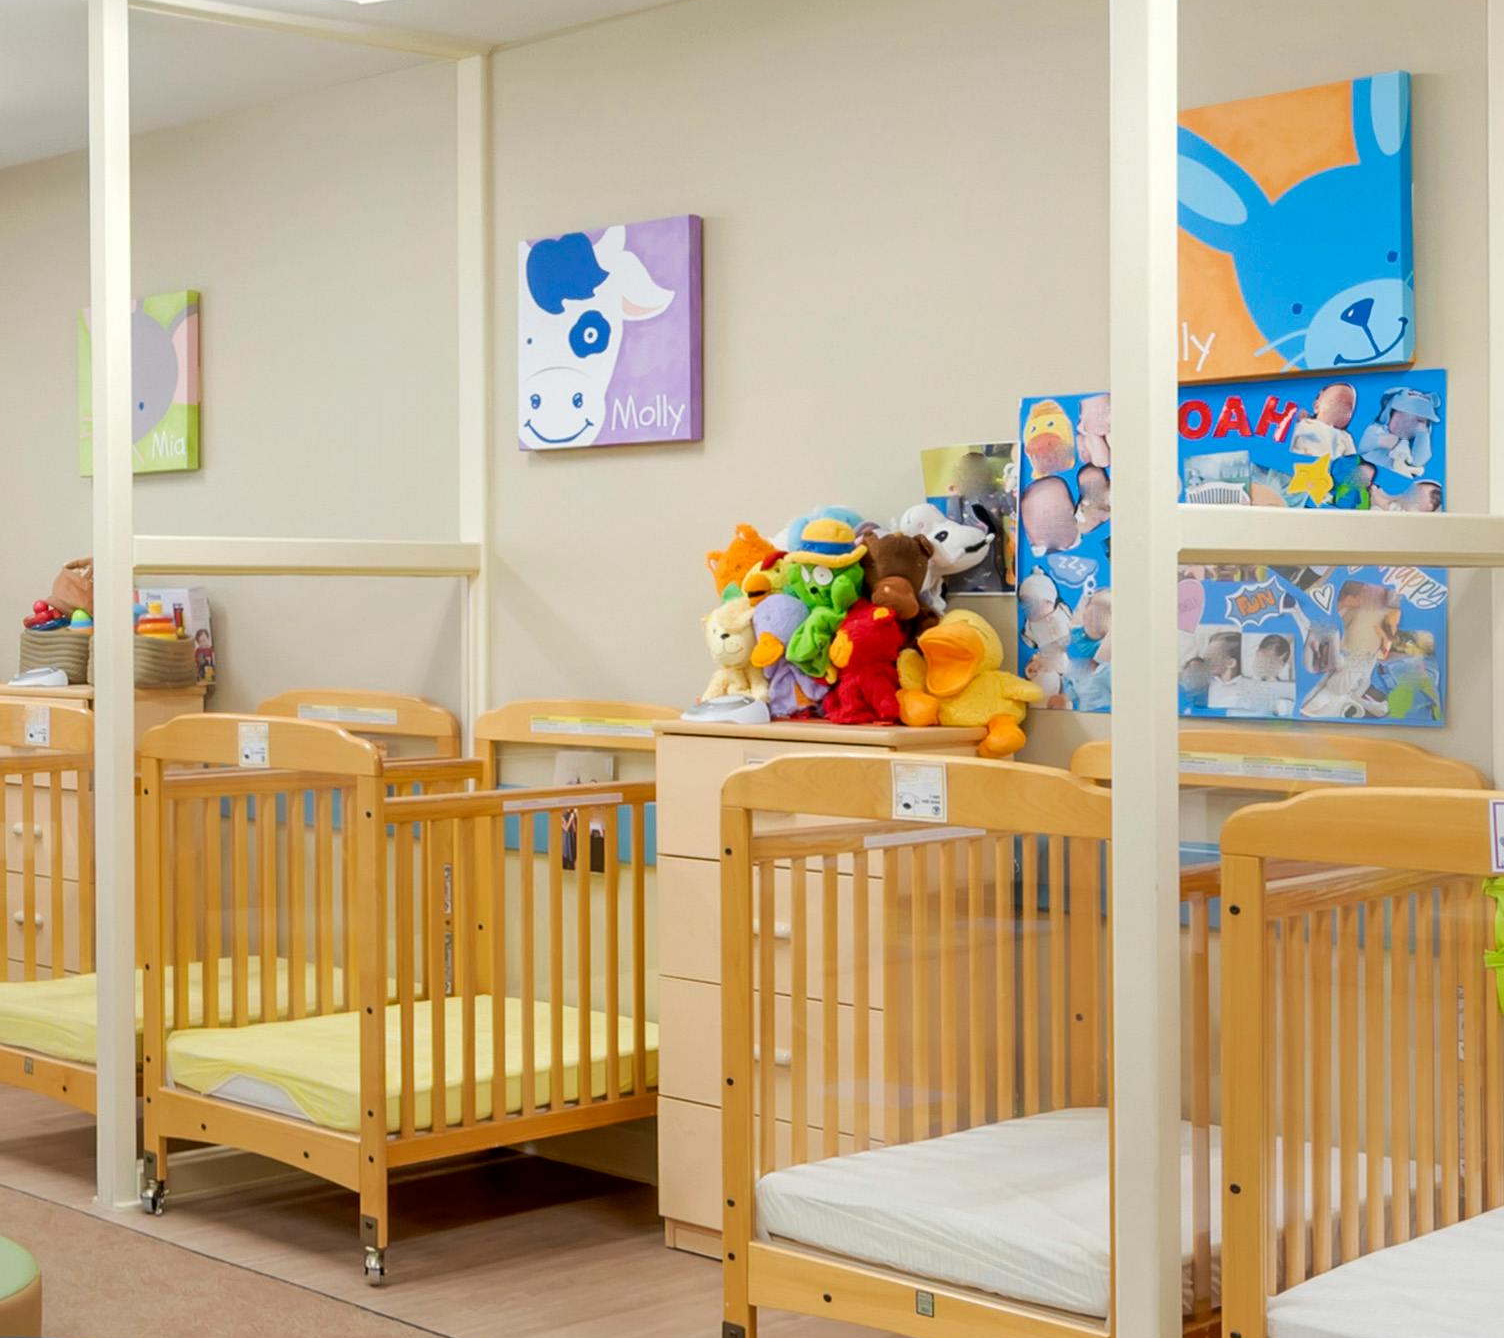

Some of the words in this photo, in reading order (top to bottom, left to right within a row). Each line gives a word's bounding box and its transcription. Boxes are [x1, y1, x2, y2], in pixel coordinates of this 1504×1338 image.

[1181, 321, 1217, 372] ly
[611, 394, 686, 436] Molly
[1178, 395, 1298, 443] OAH
[152, 430, 186, 461] Mia
